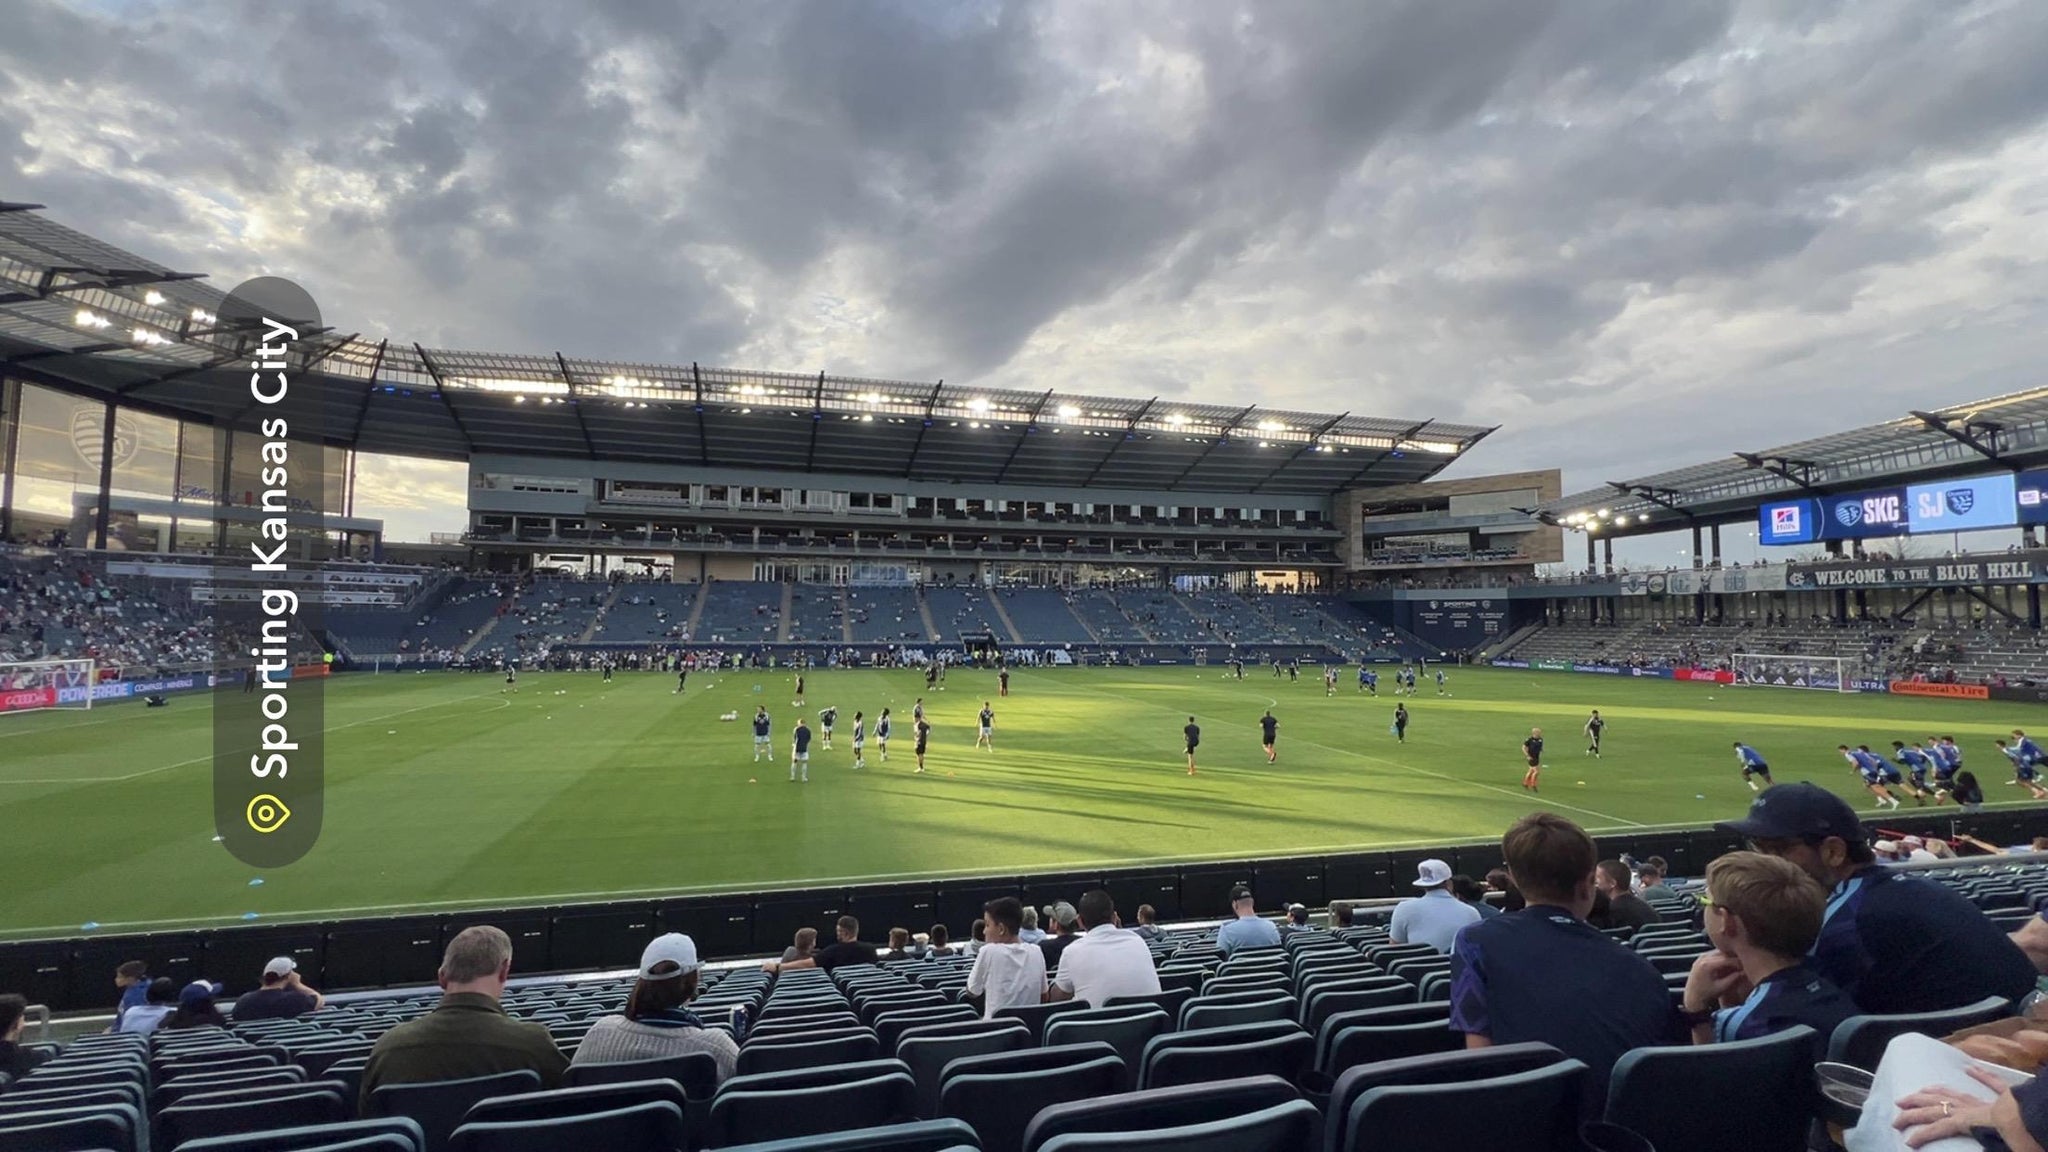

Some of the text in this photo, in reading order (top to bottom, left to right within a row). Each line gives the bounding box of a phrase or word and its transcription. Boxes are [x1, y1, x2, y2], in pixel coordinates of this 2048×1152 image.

[1863, 496, 1899, 524] SKC
[1918, 491, 1944, 518] SJ
[1815, 561, 2033, 585] WELCOME TO THE BLUE HELL
[60, 683, 128, 701] POWERADE
[1850, 680, 1886, 690] ULTRA
[1892, 680, 1949, 692] Continental
